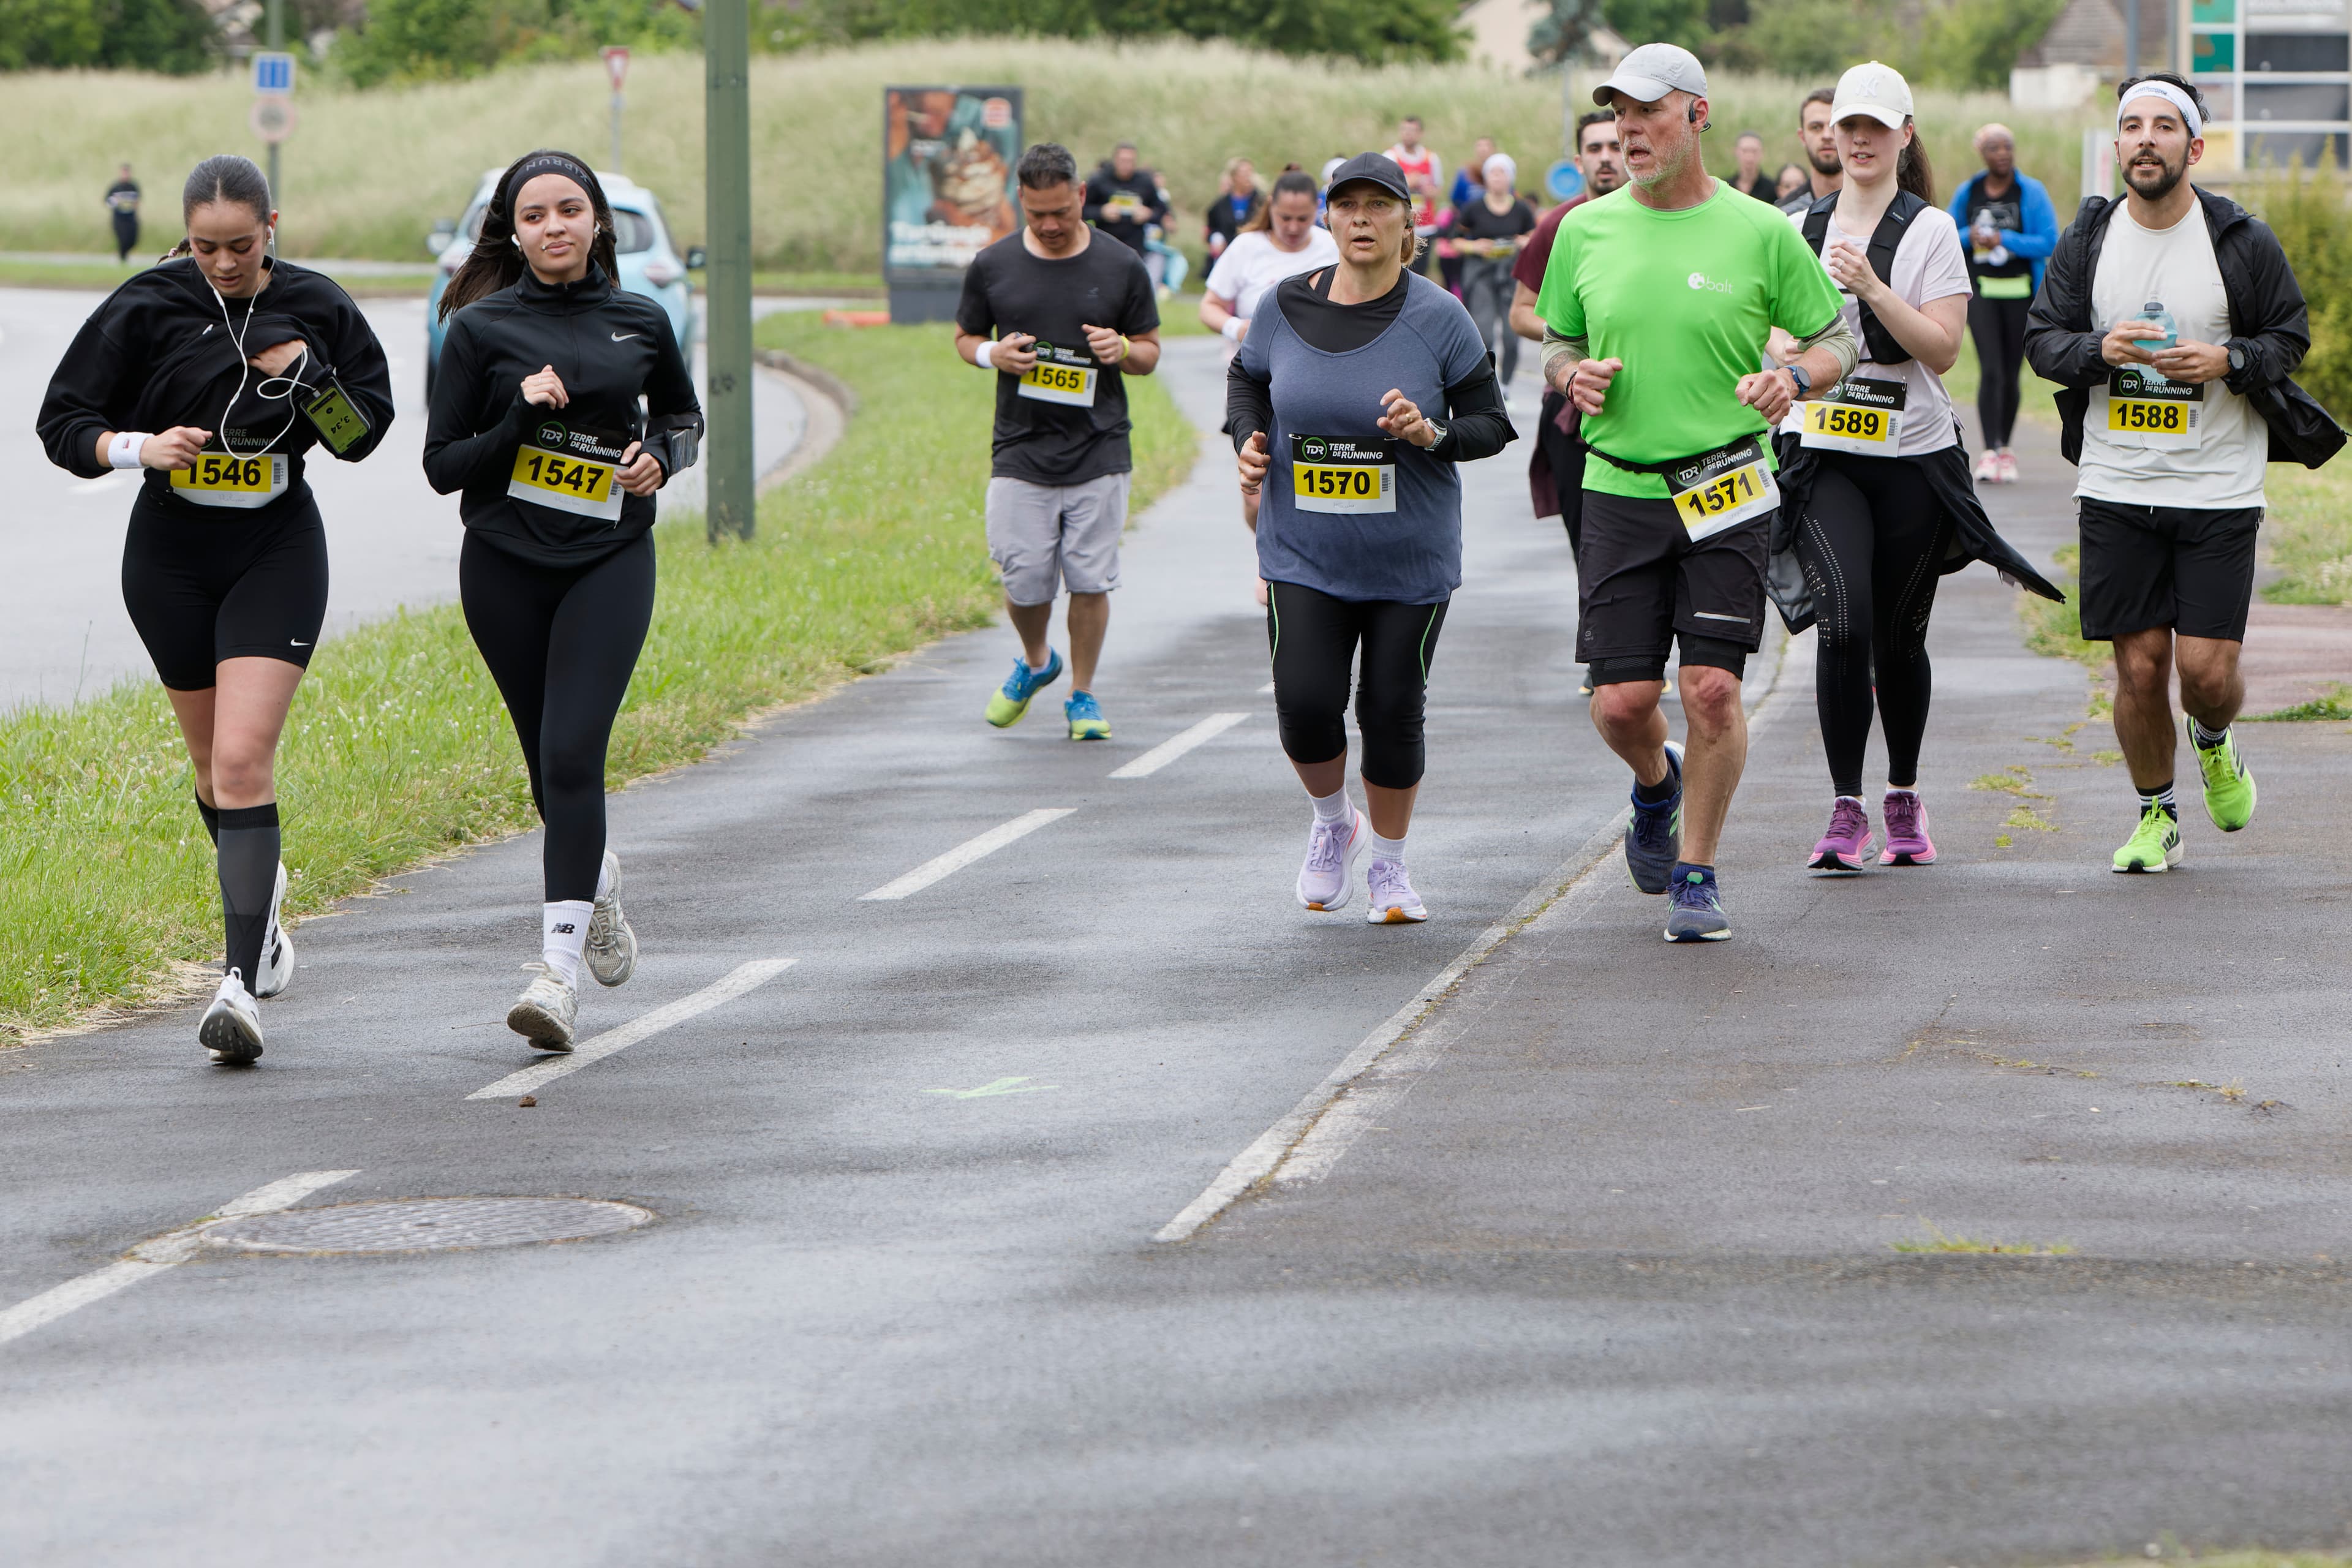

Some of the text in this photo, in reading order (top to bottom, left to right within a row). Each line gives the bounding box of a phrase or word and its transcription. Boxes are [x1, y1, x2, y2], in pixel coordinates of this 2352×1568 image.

[526, 158, 589, 183] KIPRUN
[1030, 365, 1080, 389] 1565
[2122, 379, 2138, 390] TDR
[1845, 383, 1871, 393] TERRE
[2152, 387, 2193, 396] RUNNING
[1855, 393, 1895, 404] RUNNING
[1815, 407, 1879, 435] 1589
[2117, 403, 2179, 429] 1588
[219, 428, 247, 437] ERRE
[541, 428, 564, 443] TDR
[569, 431, 598, 445] TERRE
[579, 444, 622, 459] RUNNING
[1306, 445, 1324, 455] TDR
[1701, 451, 1727, 467] TERRE
[1708, 448, 1752, 472] DE RUNNING
[189, 458, 262, 486] 1546
[528, 455, 605, 494] 1547
[1679, 466, 1699, 481] TDR
[1303, 470, 1371, 495] 1570
[1689, 472, 1754, 518] 1571
